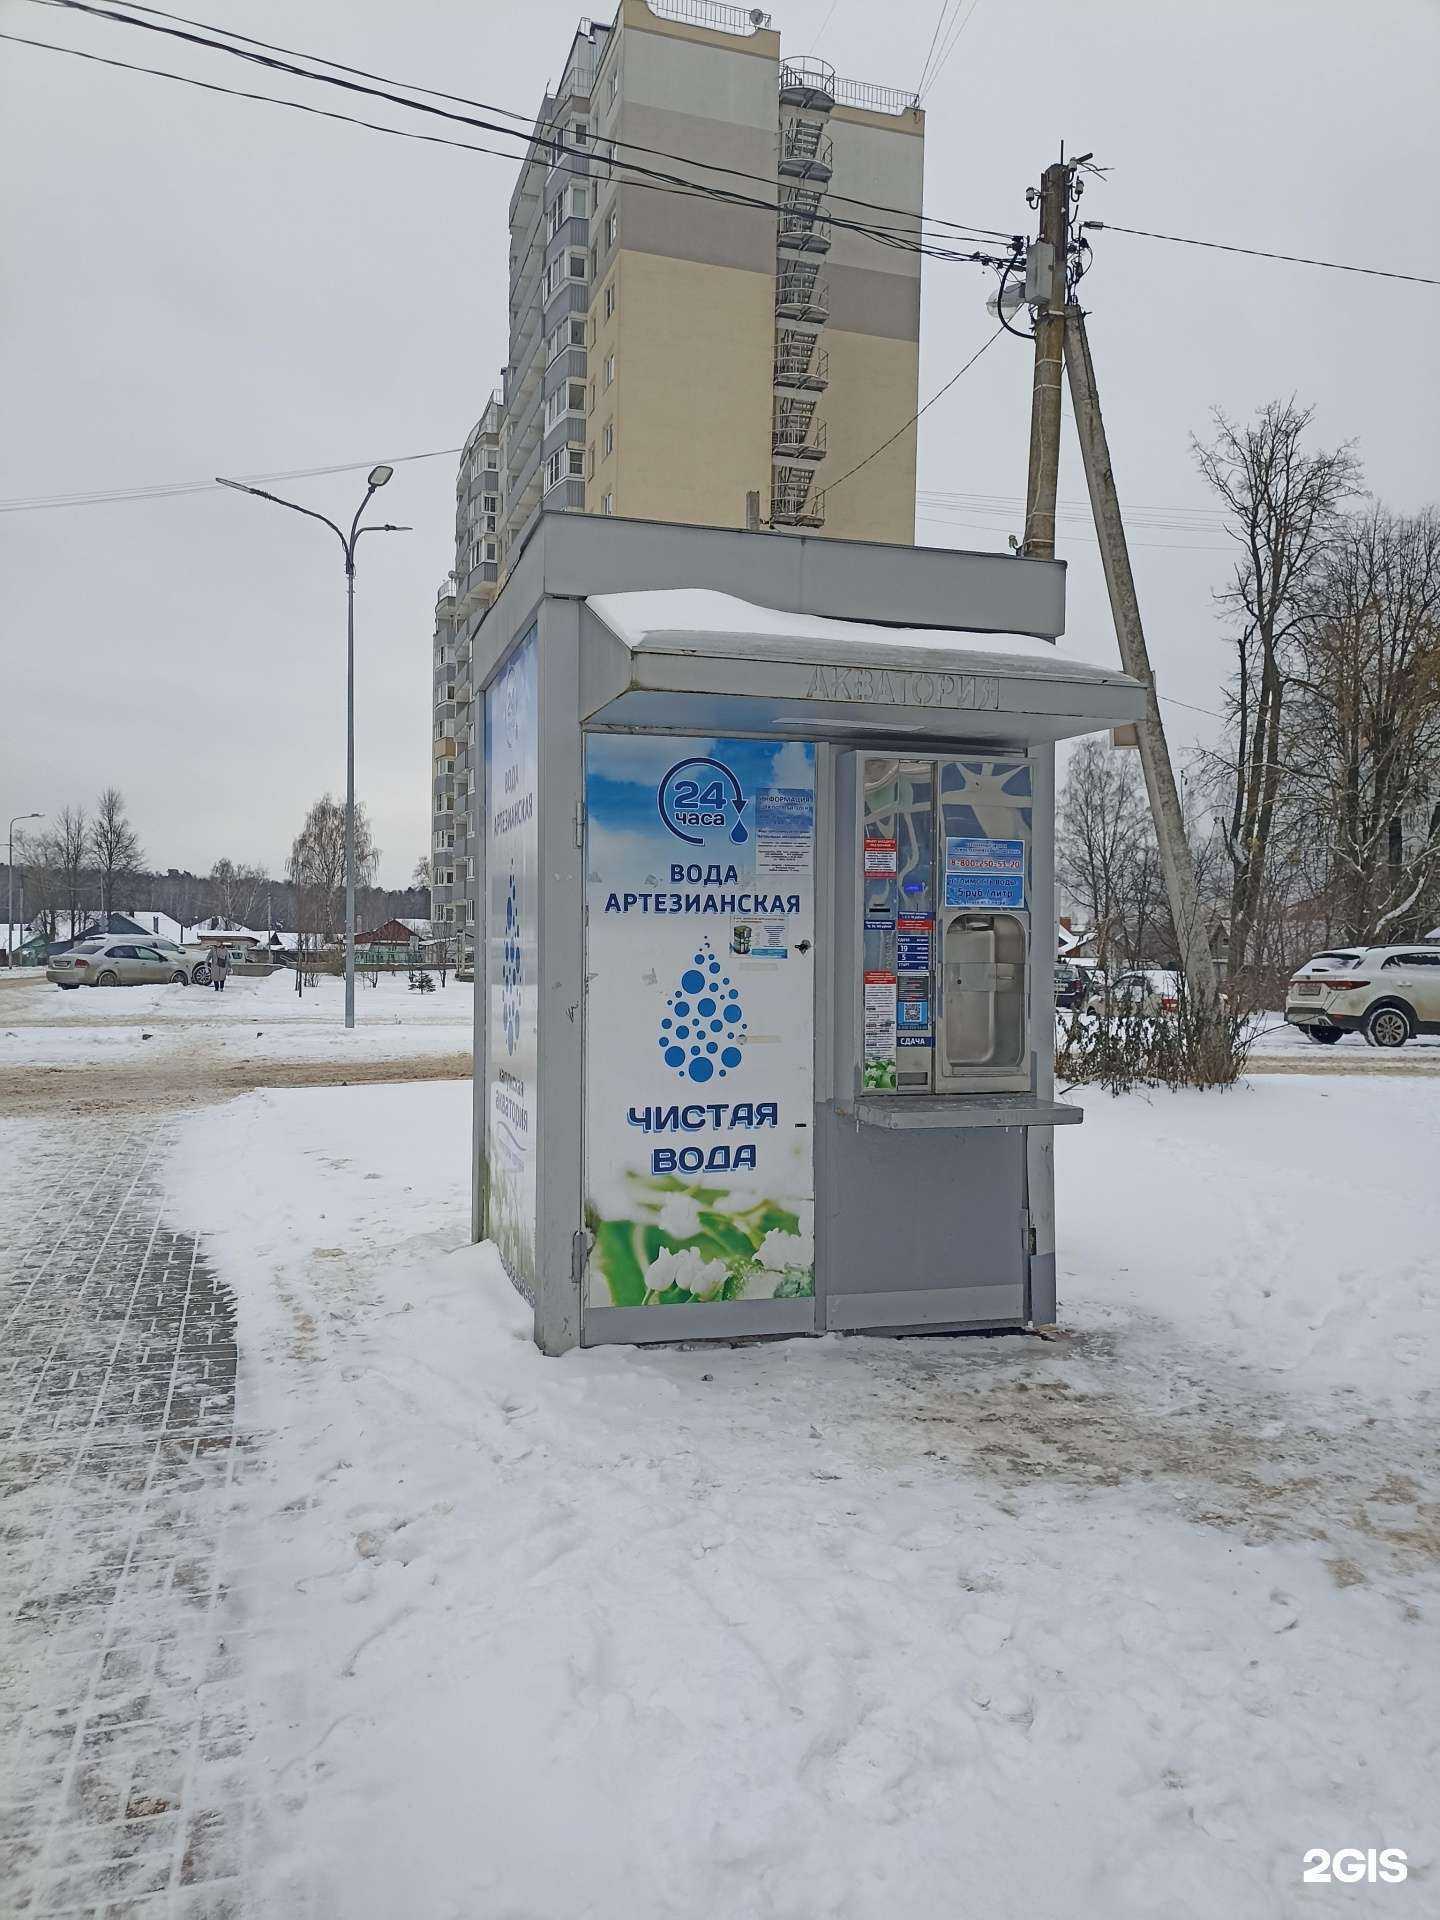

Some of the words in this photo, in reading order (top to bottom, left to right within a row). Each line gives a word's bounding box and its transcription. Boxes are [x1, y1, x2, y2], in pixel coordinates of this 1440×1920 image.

[806, 665, 1000, 710] АКВАТОРИЯ
[673, 780, 727, 810] 24
[674, 811, 726, 827] часа
[670, 863, 738, 886] ВОДА
[605, 892, 801, 914] АРТЕЗИАНСКАЯ
[900, 1037, 925, 1045] СДАЧА
[627, 1102, 778, 1133] ЧИСТАЯ
[651, 1144, 757, 1176] ВОДА
